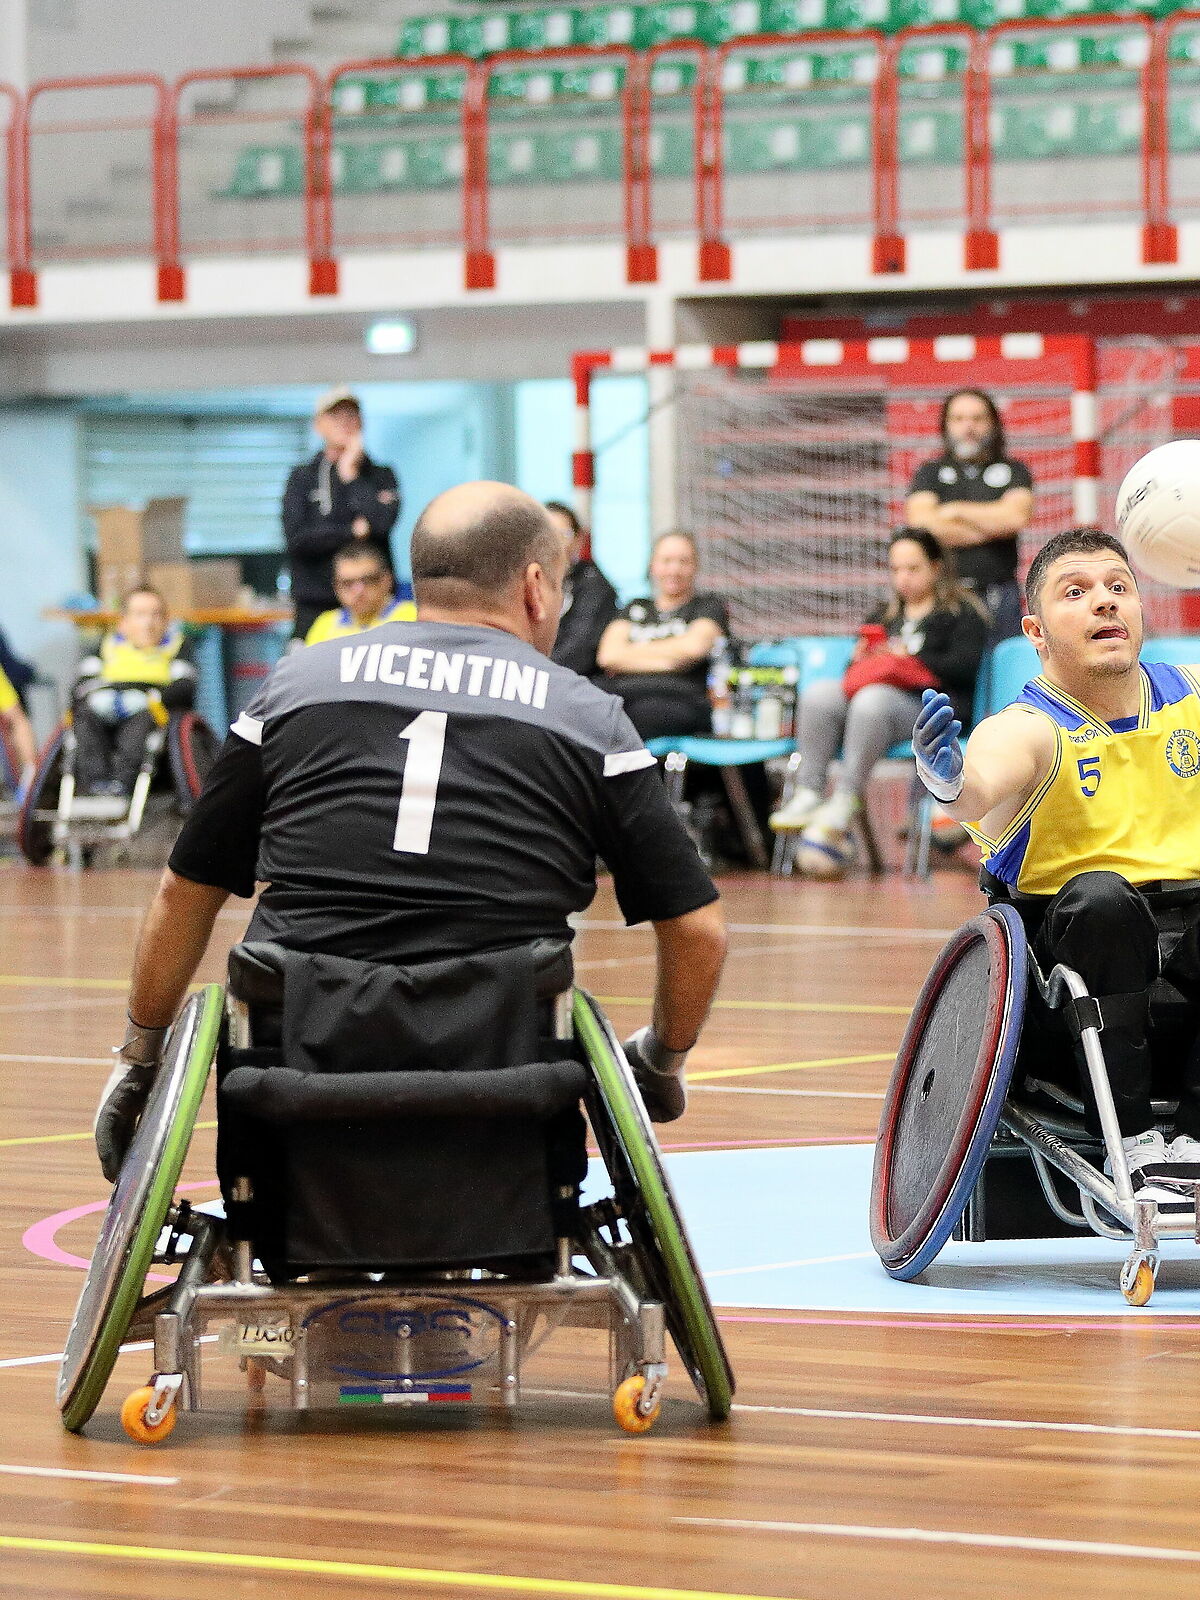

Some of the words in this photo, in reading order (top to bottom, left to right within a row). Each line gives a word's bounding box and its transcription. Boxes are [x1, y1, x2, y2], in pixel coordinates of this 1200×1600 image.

[340, 644, 549, 709] VICENTINI
[393, 710, 447, 854] 1
[1077, 757, 1101, 797] 5
